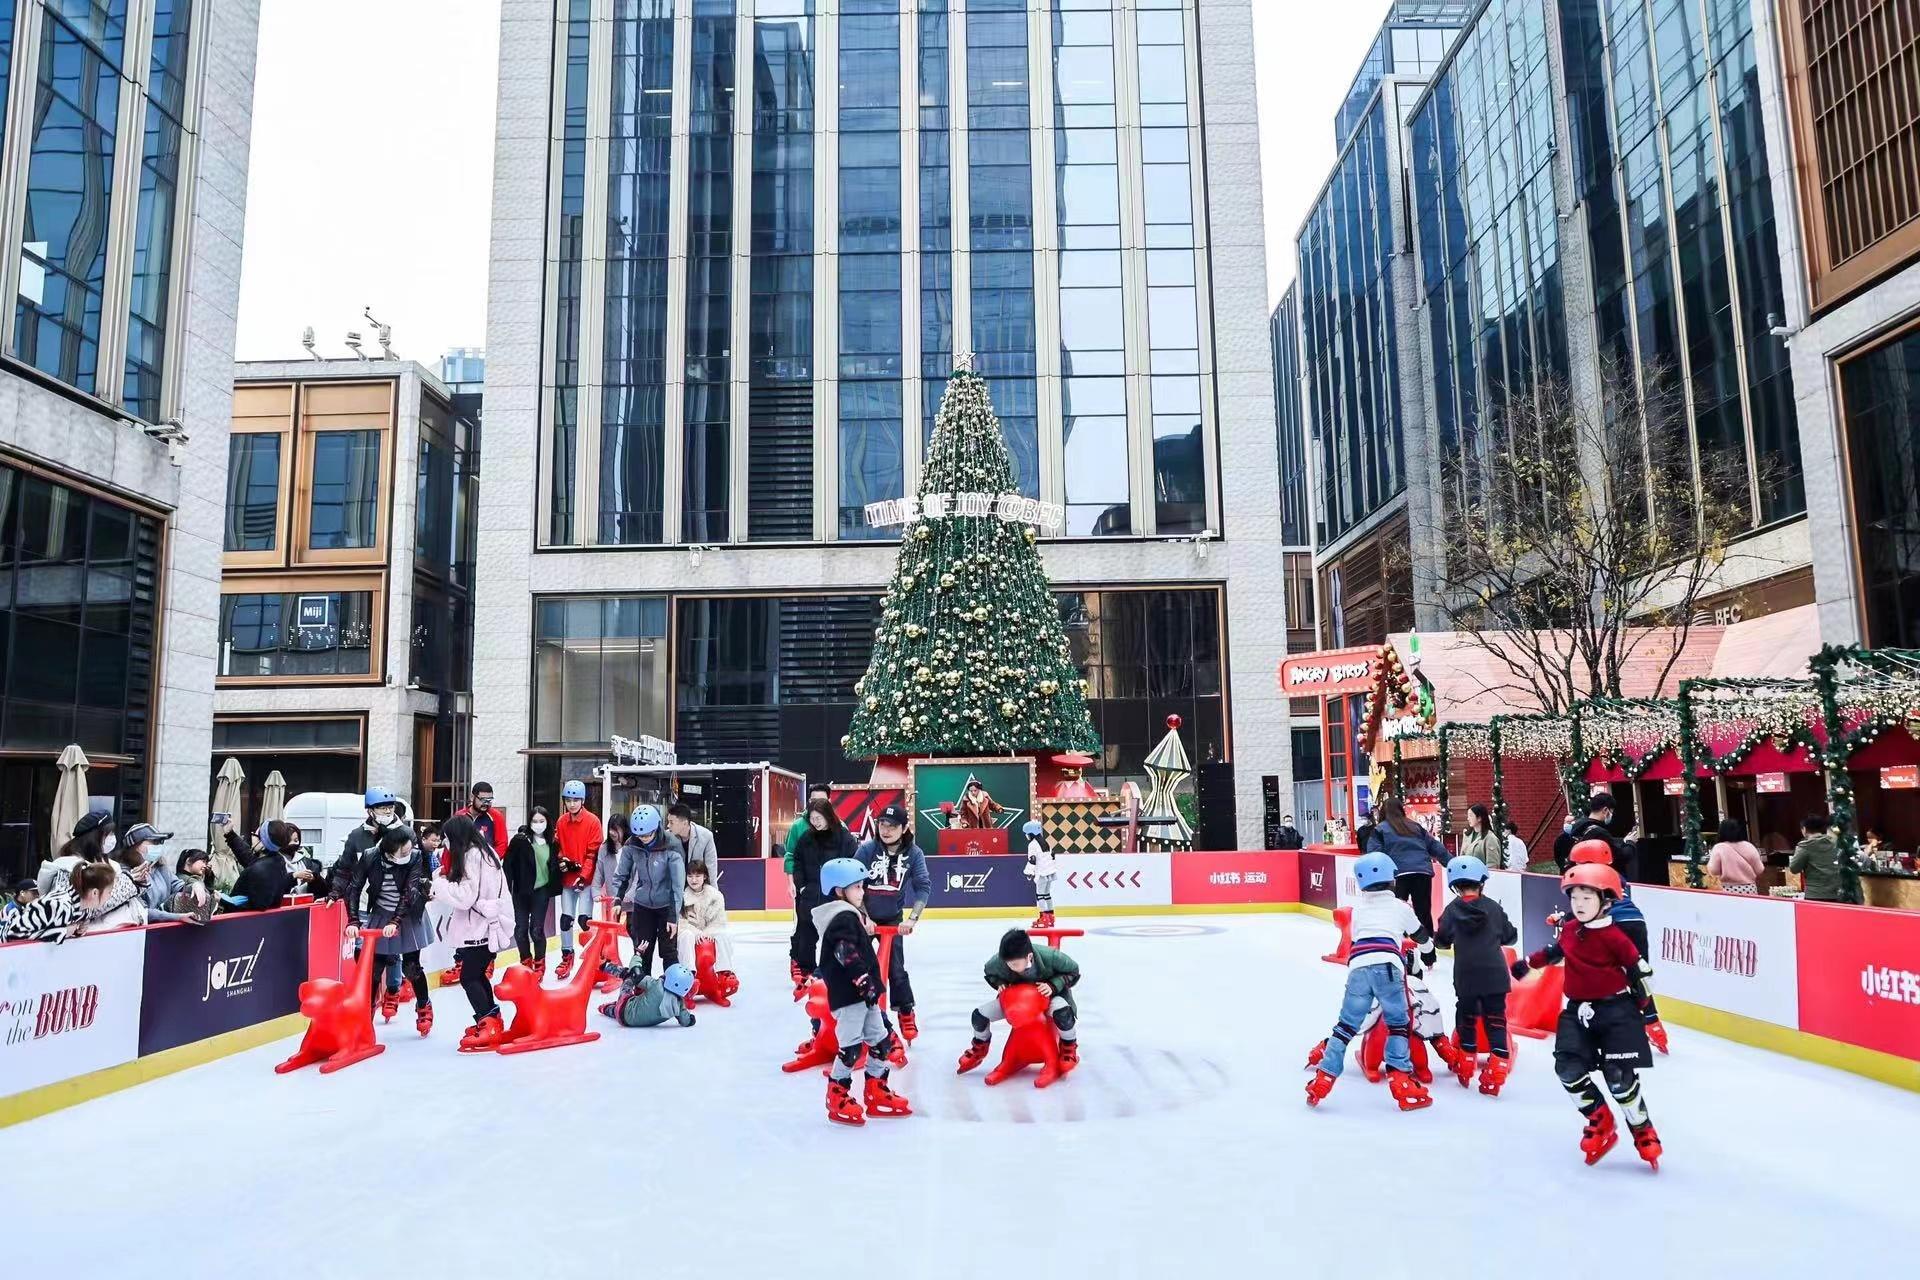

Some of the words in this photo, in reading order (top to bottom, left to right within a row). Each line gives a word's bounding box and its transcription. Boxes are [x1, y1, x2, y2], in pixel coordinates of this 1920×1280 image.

[864, 495, 921, 528] TIME
[922, 493, 951, 518] OF
[954, 491, 994, 517] JOY
[997, 494, 1065, 529] @BFC
[303, 606, 322, 618] Miji
[1715, 603, 1742, 626] BFC
[1290, 666, 1329, 685] ANGRY
[1330, 660, 1370, 683] BIRDS
[1209, 871, 1241, 884] 小红书
[1244, 871, 1267, 884] 运动
[1661, 927, 1697, 966] RINK
[1713, 935, 1758, 978] BUND
[202, 938, 264, 1001] jazz
[226, 986, 253, 998] SHANGHAI
[1861, 964, 1920, 1004] 小红书
[11, 999, 33, 1017] on
[33, 984, 98, 1040] BUND
[7, 1019, 32, 1046] the
